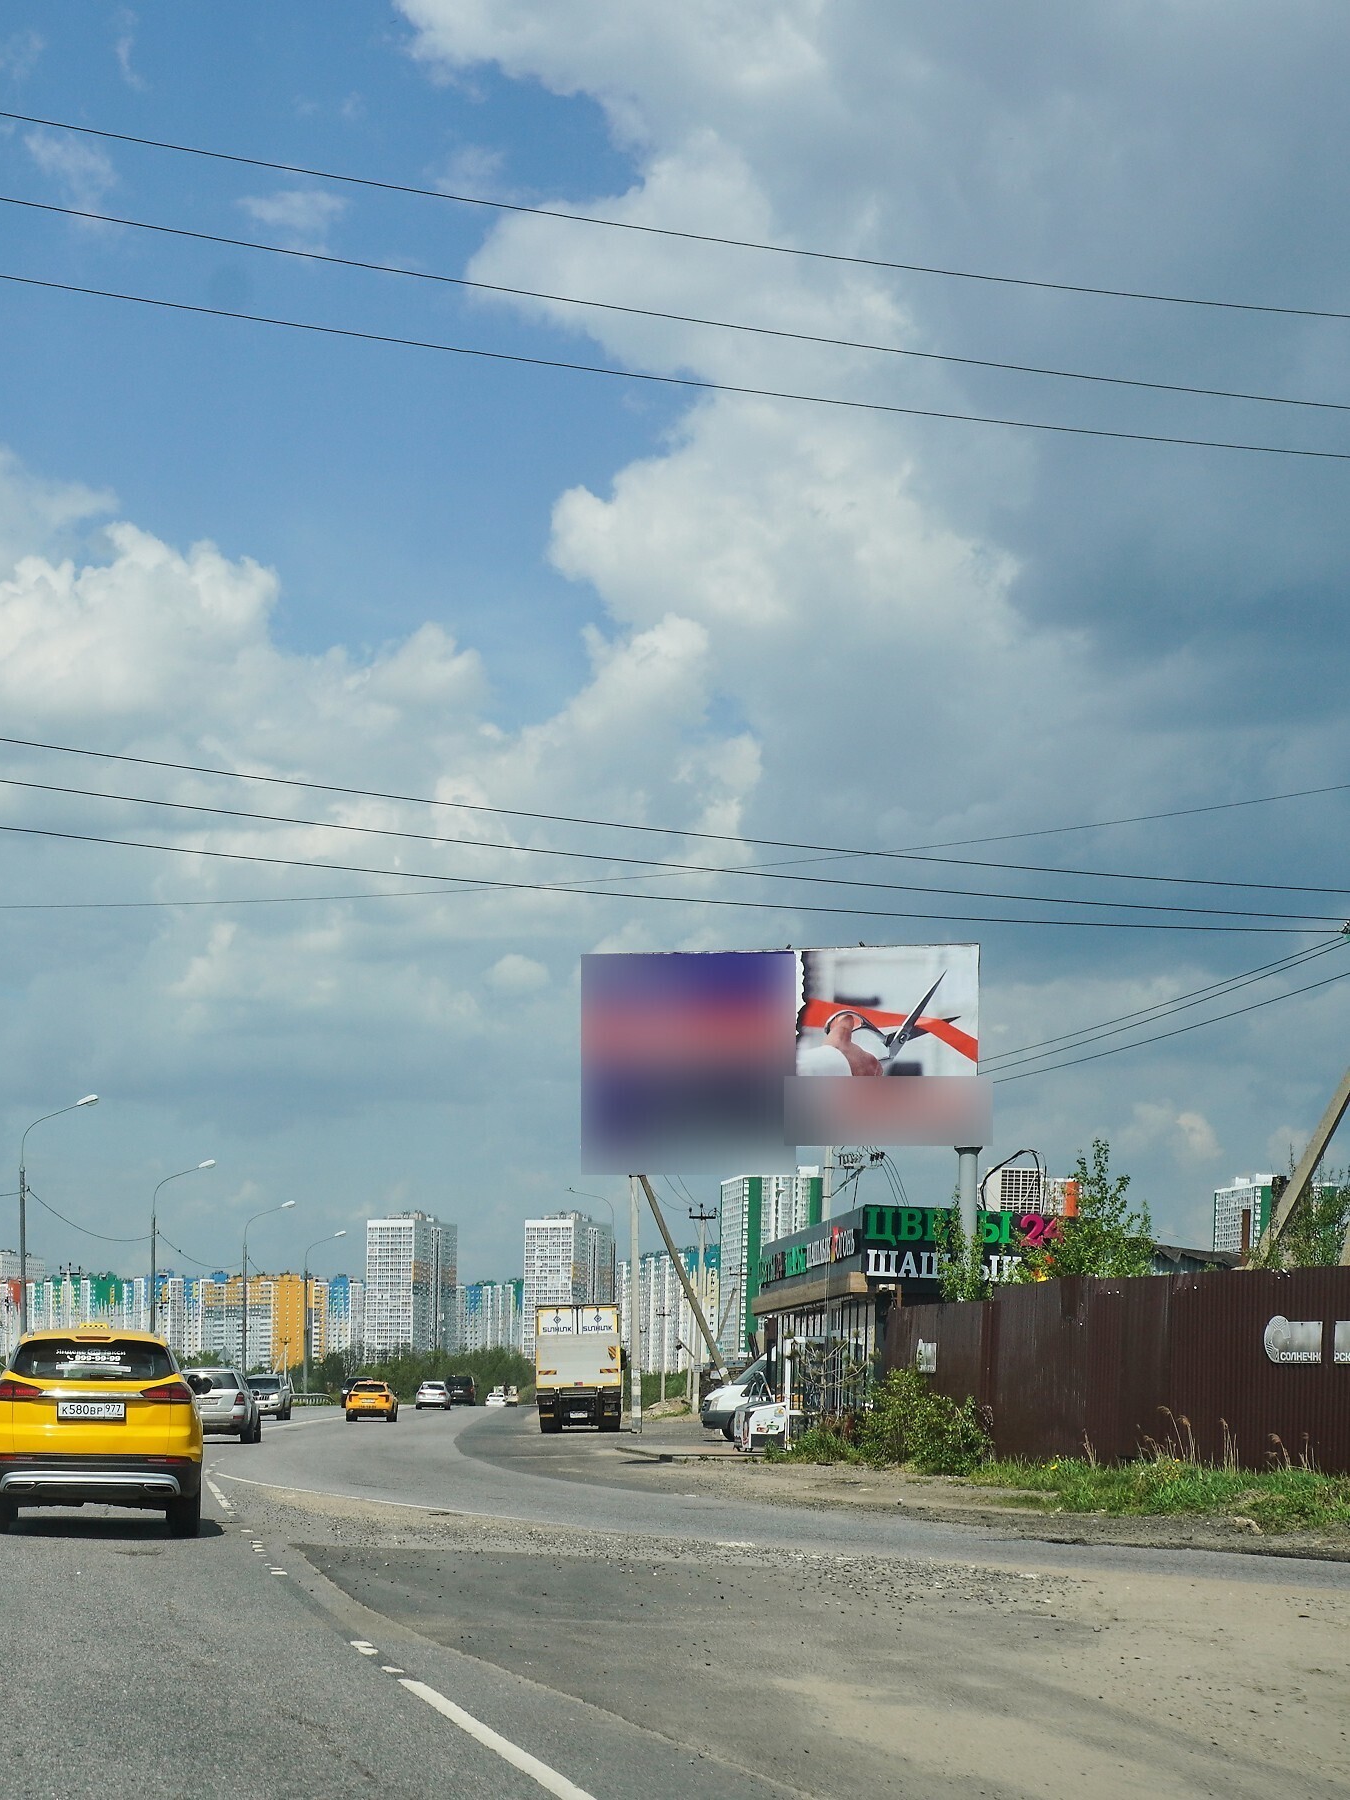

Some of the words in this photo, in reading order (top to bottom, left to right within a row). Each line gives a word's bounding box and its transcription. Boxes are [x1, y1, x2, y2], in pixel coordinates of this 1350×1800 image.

[864, 1207, 1013, 1246] ЦВЕЫ
[866, 1249, 1022, 1282] ШАШЫК
[105, 1404, 121, 1413] 977
